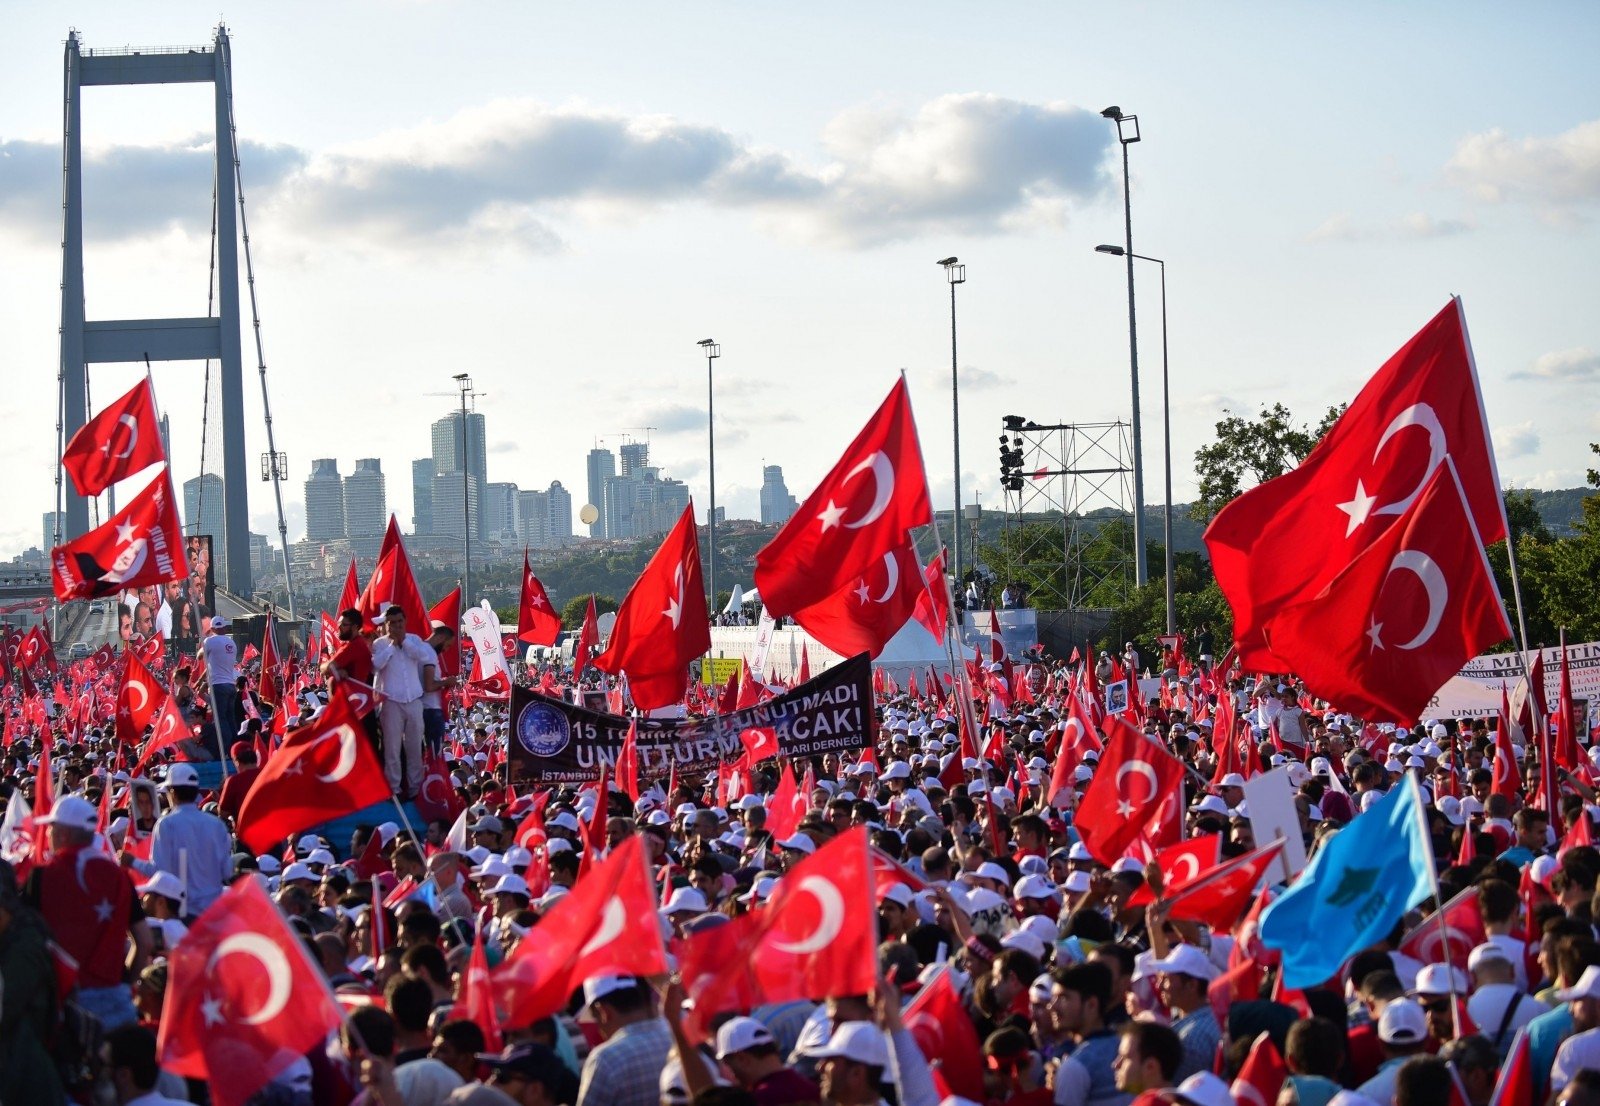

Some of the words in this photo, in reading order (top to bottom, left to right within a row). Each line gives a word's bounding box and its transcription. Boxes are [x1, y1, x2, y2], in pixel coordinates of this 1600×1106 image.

[1501, 669, 1513, 677] 15
[573, 722, 597, 740] 15
[812, 734, 863, 751] DERNEĞİ
